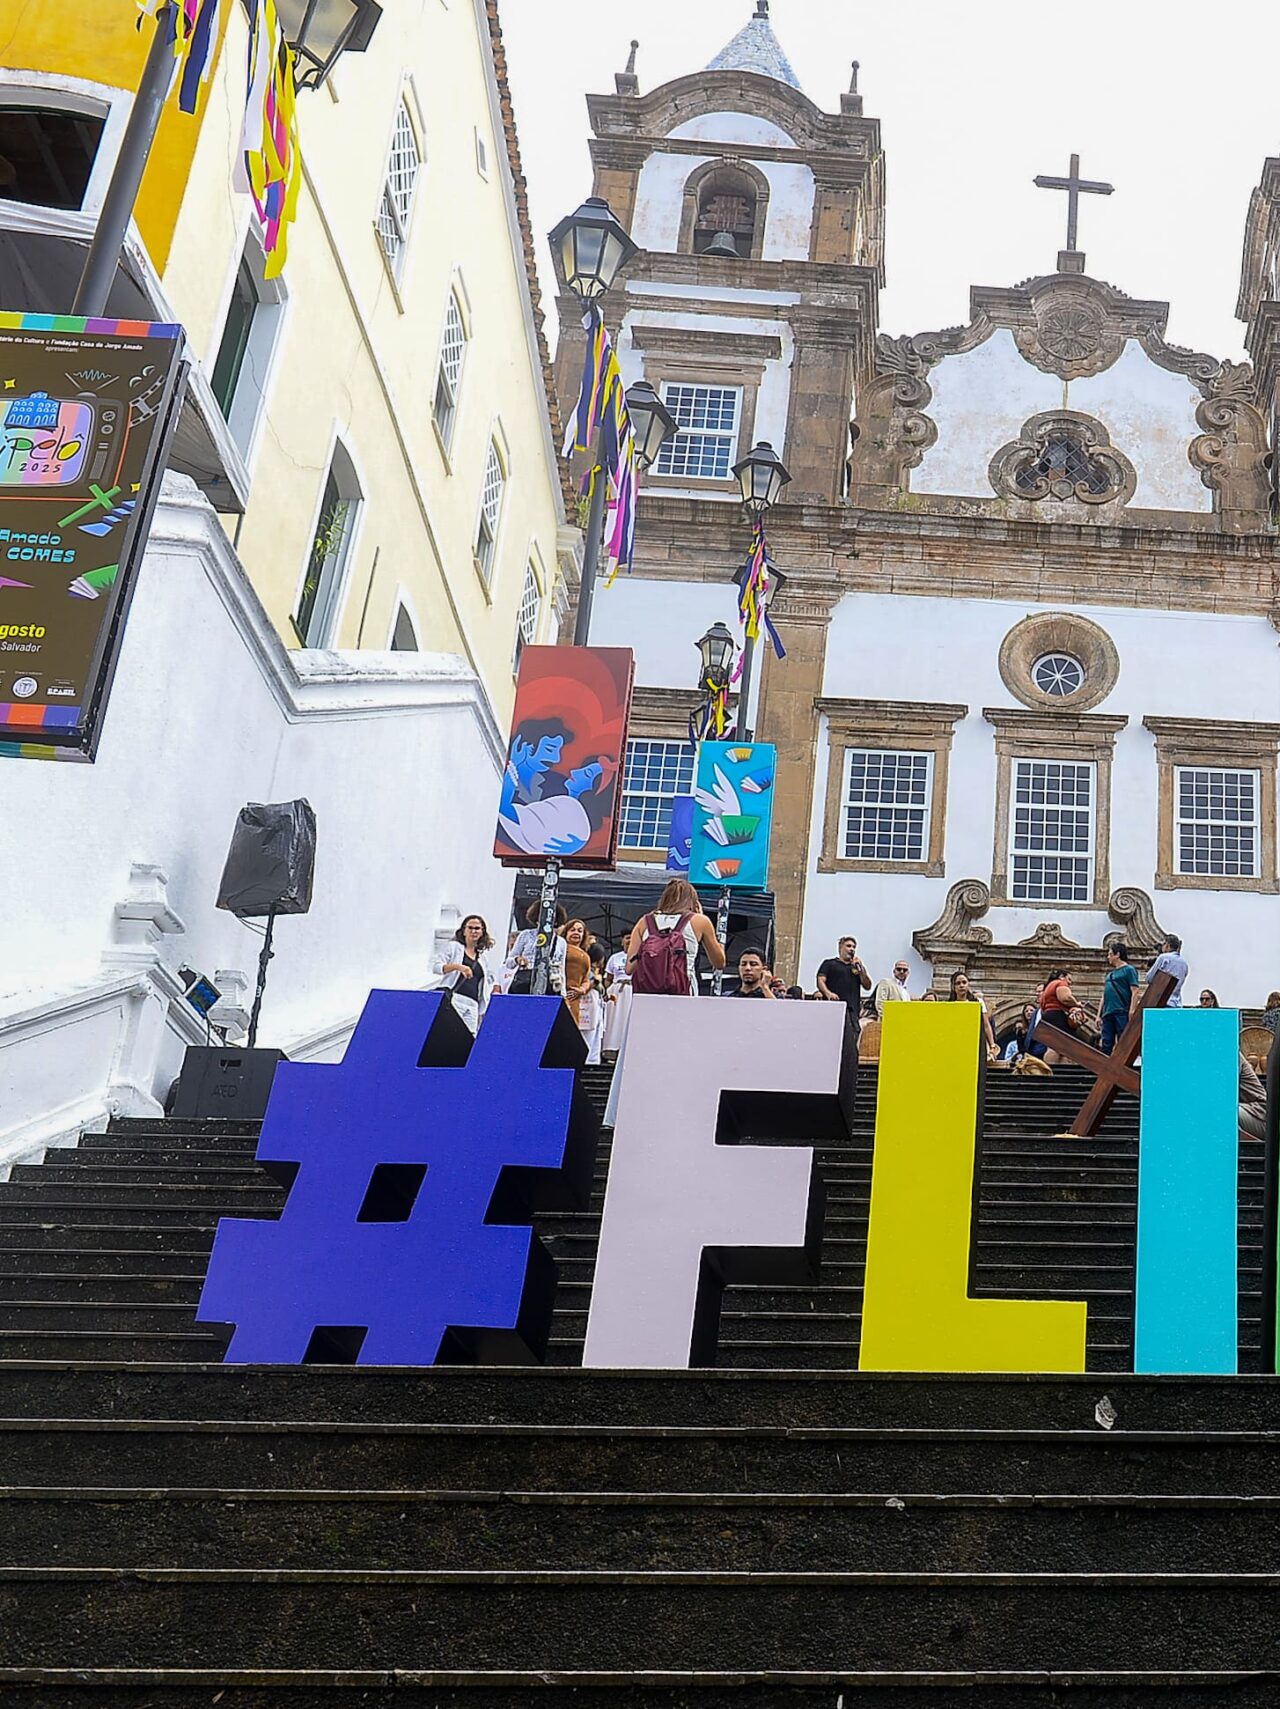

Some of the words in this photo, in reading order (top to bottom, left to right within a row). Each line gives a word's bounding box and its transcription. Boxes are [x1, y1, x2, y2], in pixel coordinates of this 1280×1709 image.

[23, 337, 45, 345] Cultura
[51, 339, 79, 347] Fundação
[80, 340, 95, 348] Casa
[104, 342, 122, 350] Jorge
[122, 343, 143, 351] Amado
[19, 462, 61, 473] 2025
[0, 529, 61, 545] Amado
[7, 546, 76, 564] GOMES
[1, 641, 42, 653] Salvador
